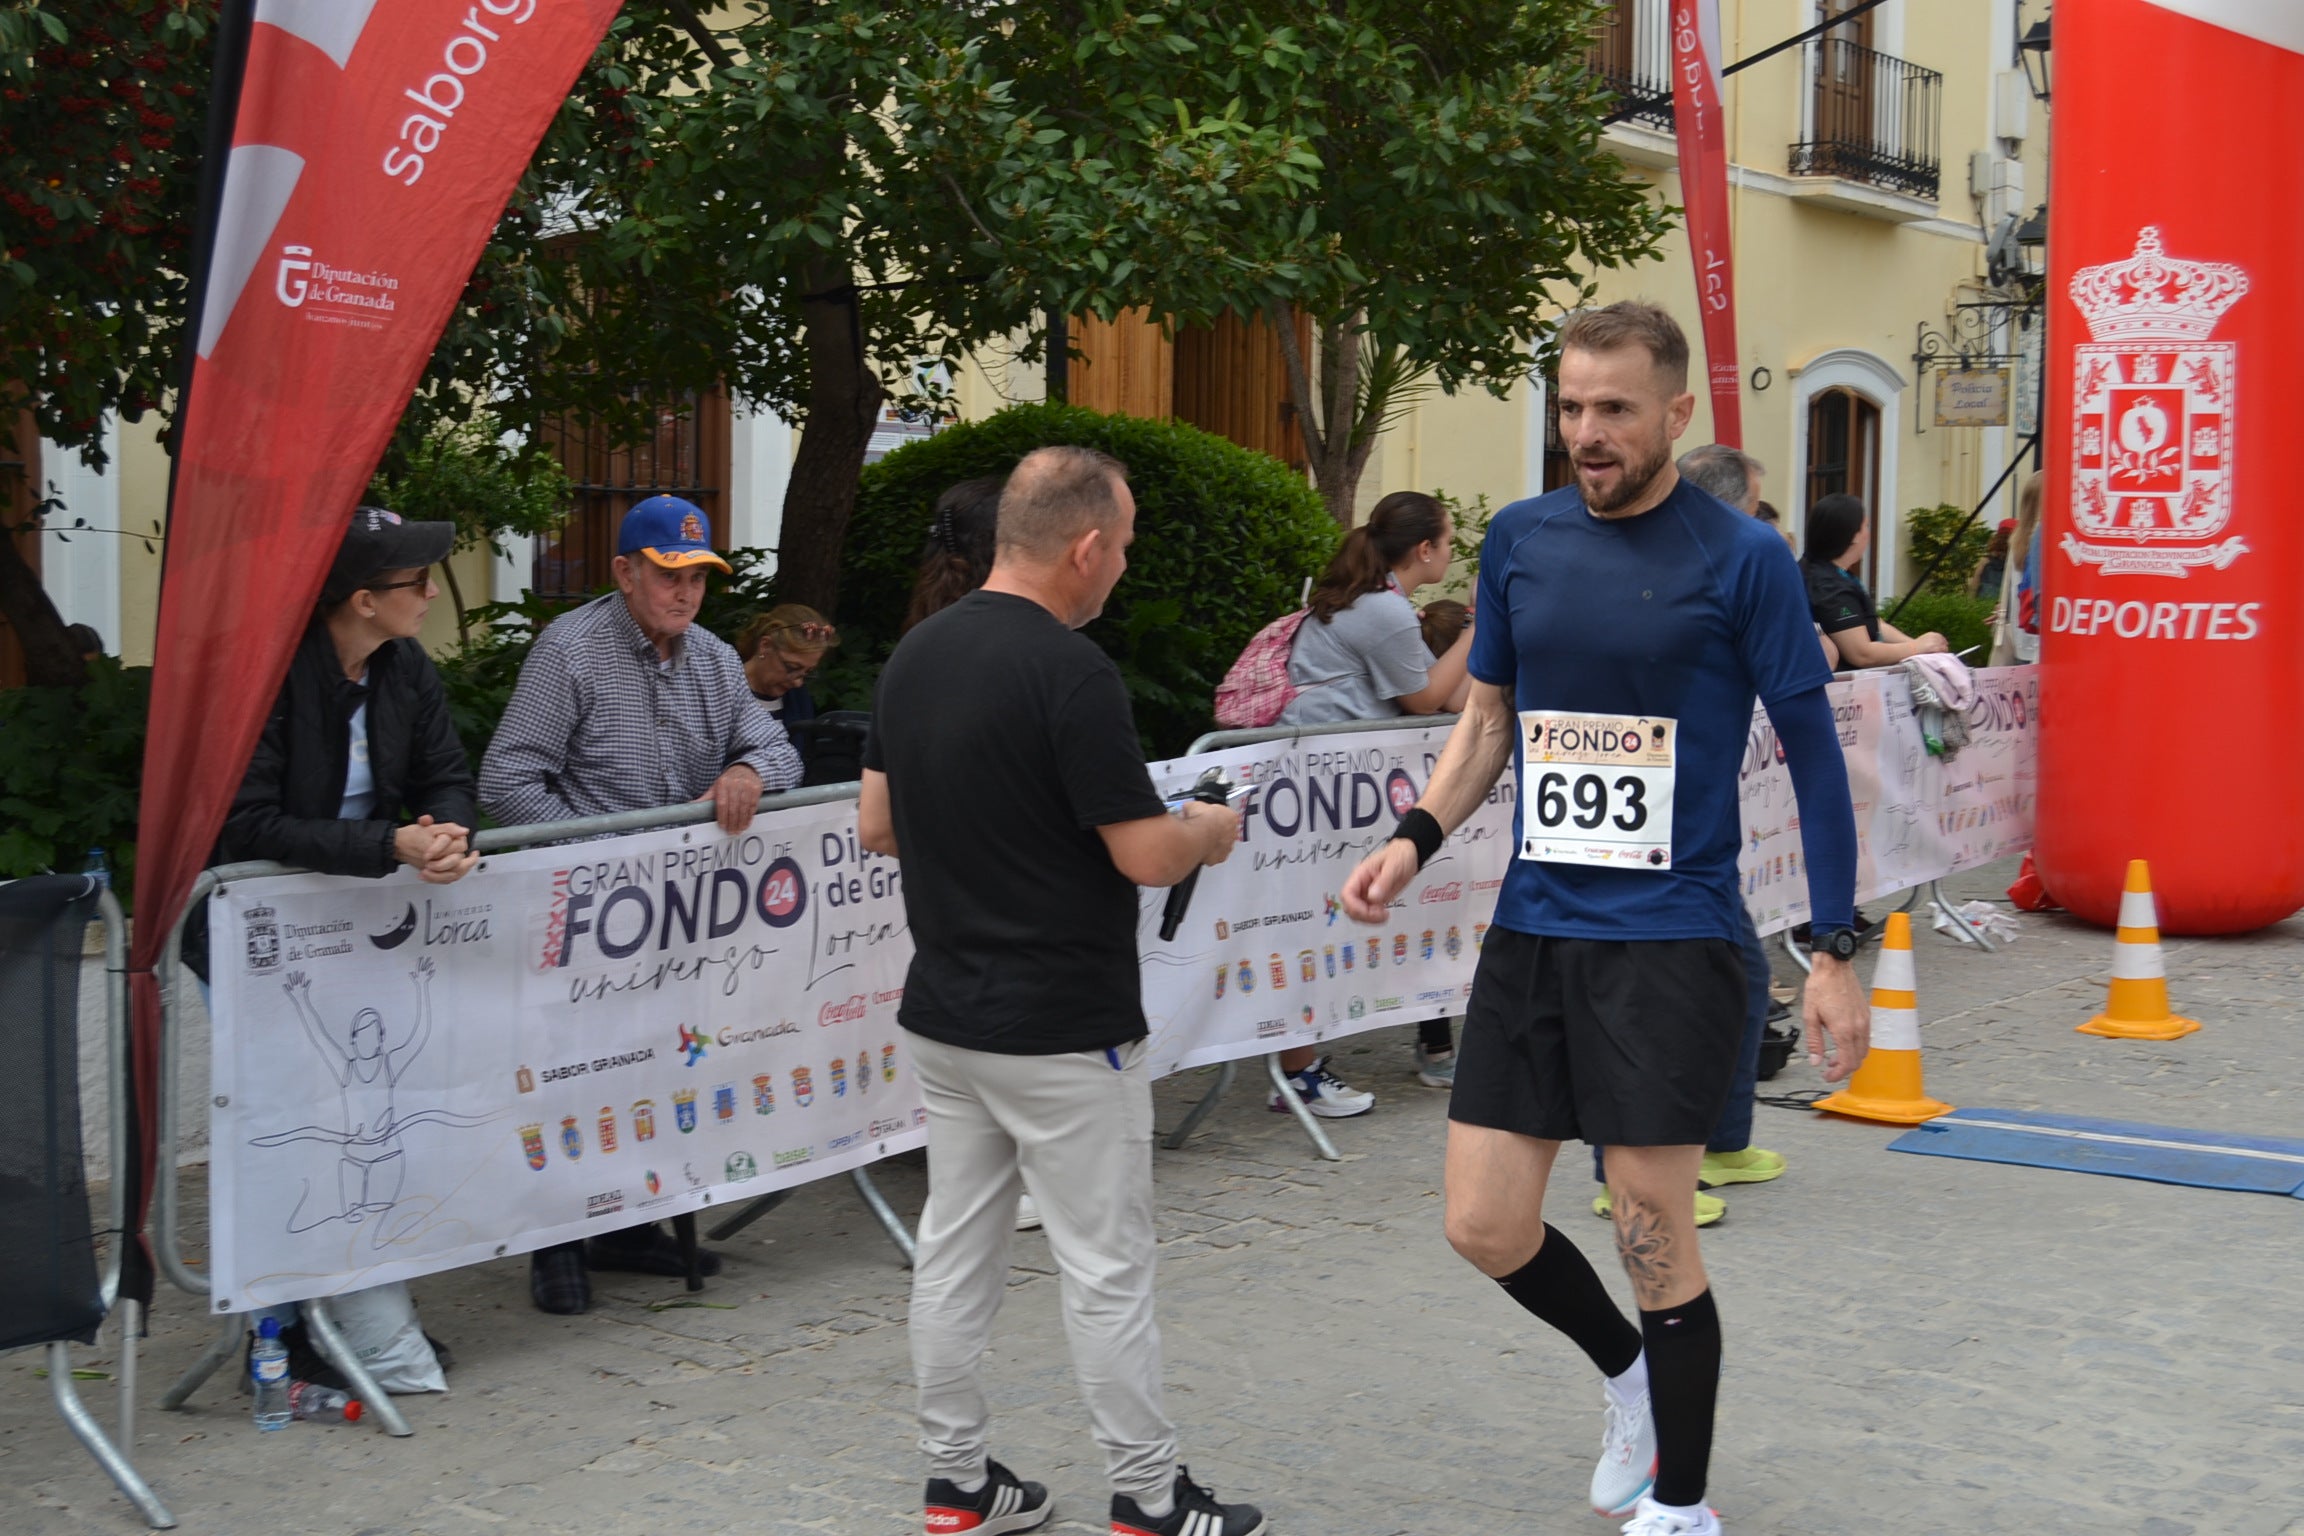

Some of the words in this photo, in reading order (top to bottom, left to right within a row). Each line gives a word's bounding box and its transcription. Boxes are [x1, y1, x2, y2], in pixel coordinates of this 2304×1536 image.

[311, 262, 399, 290] Diputación
[307, 283, 325, 301] de
[325, 285, 395, 311] Granada
[1953, 399, 1990, 410] Local
[2050, 596, 2260, 641] DEPORTES
[1549, 728, 1642, 753] FONDO
[1550, 718, 1582, 732] GRAN
[1583, 719, 1624, 732] PREMIO
[1624, 738, 1639, 750] 24
[1251, 755, 1299, 783] GRAN
[1305, 748, 1384, 777] PREMIO
[1392, 786, 1414, 807] 24
[1537, 772, 1648, 832] 693
[566, 853, 655, 897] GRAN
[663, 835, 765, 881] PREMIO
[772, 841, 793, 858] DE
[766, 876, 797, 907] 24
[826, 871, 862, 908] de
[423, 898, 493, 947] Lorca
[539, 868, 570, 970] XXXVII
[557, 856, 808, 968] FONDO
[284, 919, 354, 941] Diputación
[287, 945, 304, 962] de
[304, 940, 354, 960] Granada
[569, 943, 780, 1003] universo
[717, 1018, 801, 1047] Granada
[541, 1063, 590, 1083] SABOR
[590, 1047, 656, 1073] GRANADA
